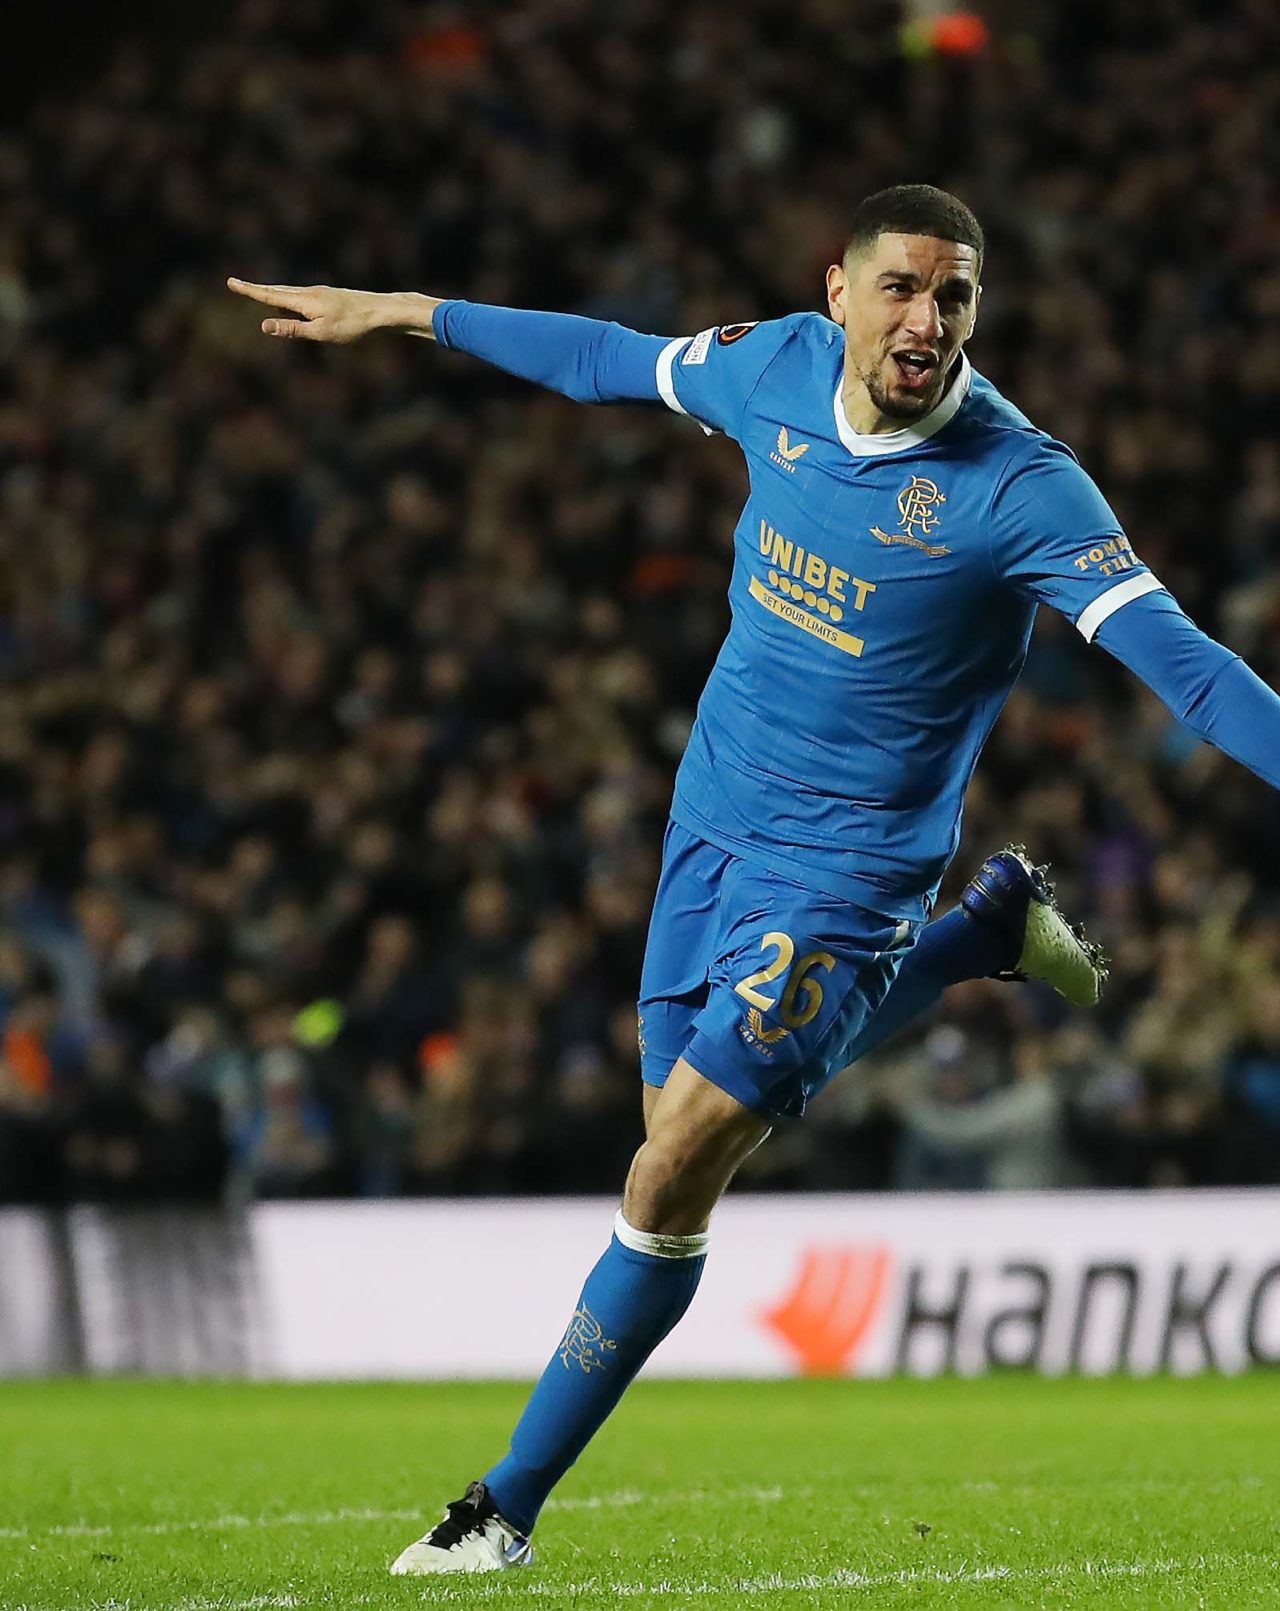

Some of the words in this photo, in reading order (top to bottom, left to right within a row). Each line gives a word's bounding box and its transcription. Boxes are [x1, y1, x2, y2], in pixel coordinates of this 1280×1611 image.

[759, 518, 877, 612] UNIBET
[1099, 551, 1140, 577] TIRE
[763, 592, 778, 610] SET
[780, 603, 806, 624] YOUR
[806, 618, 839, 643] LIMITS
[734, 931, 837, 1029] 26
